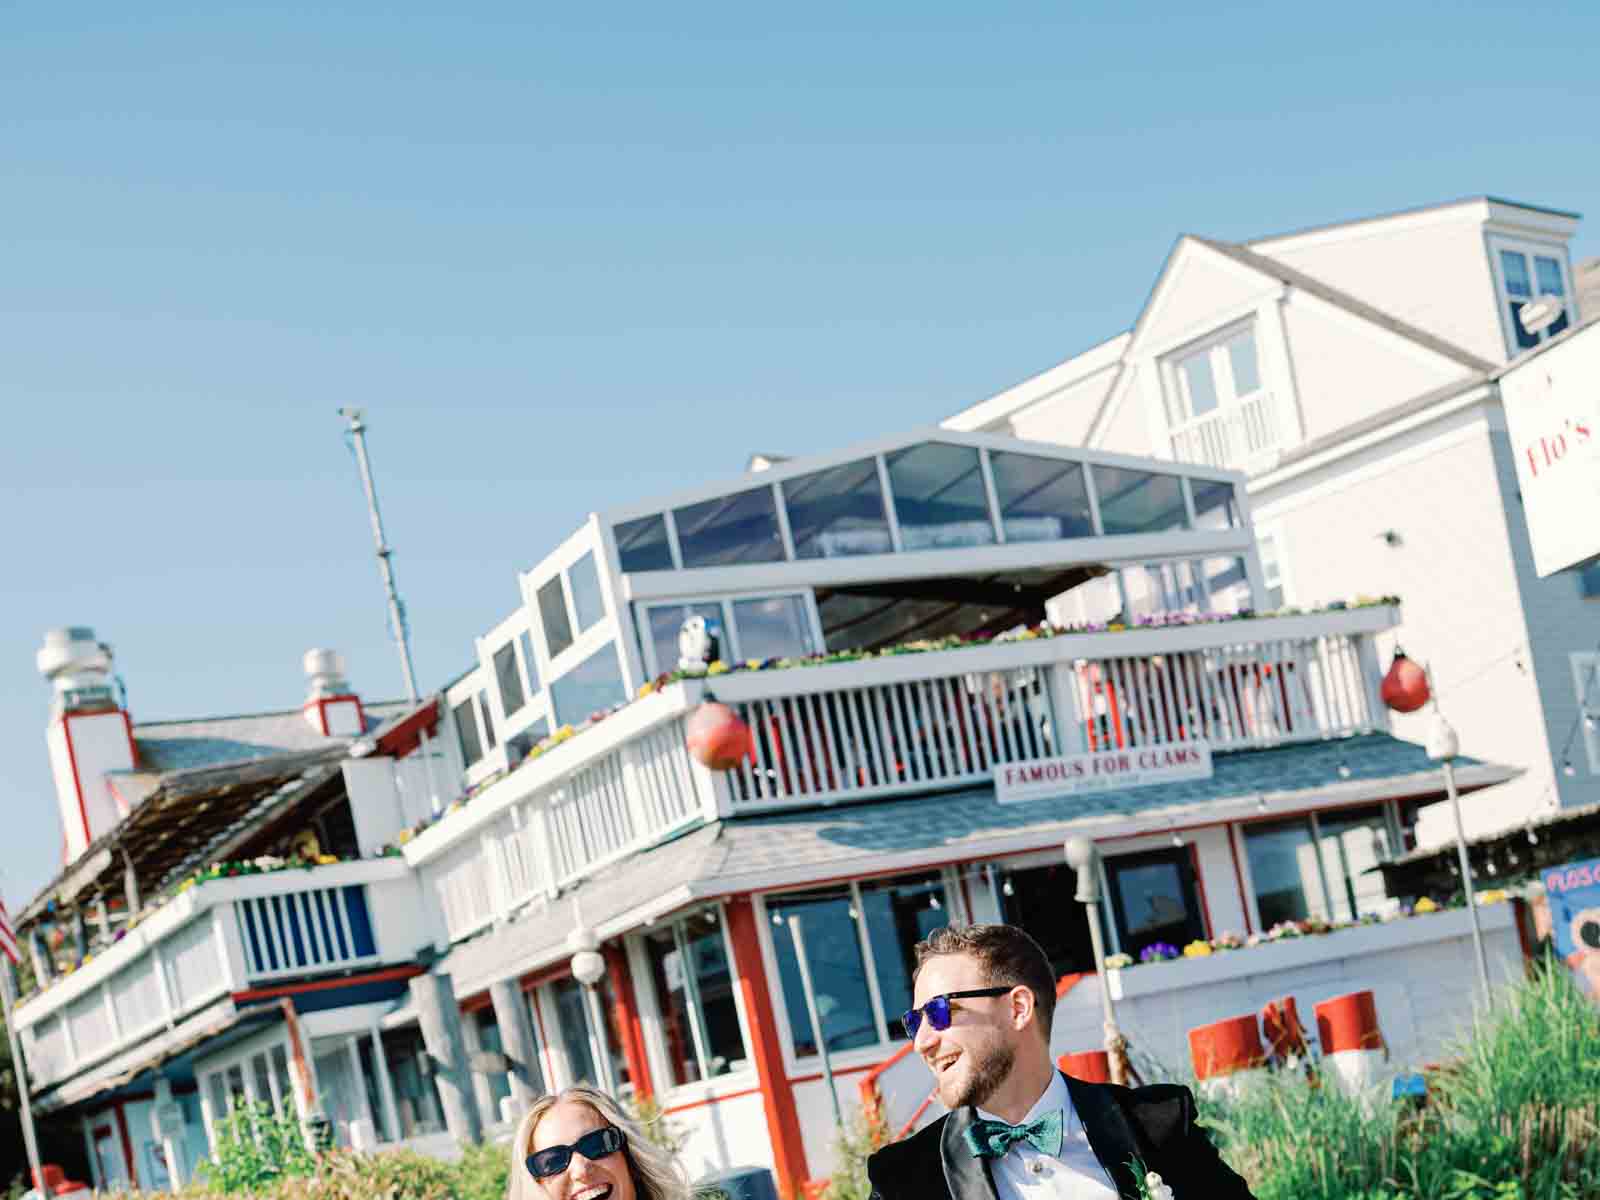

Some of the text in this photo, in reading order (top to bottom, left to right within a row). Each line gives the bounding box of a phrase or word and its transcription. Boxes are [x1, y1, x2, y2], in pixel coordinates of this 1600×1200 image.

[1005, 762, 1084, 785] FAMOUS
[1093, 754, 1130, 776] FOR
[1139, 748, 1202, 769] CLAMS
